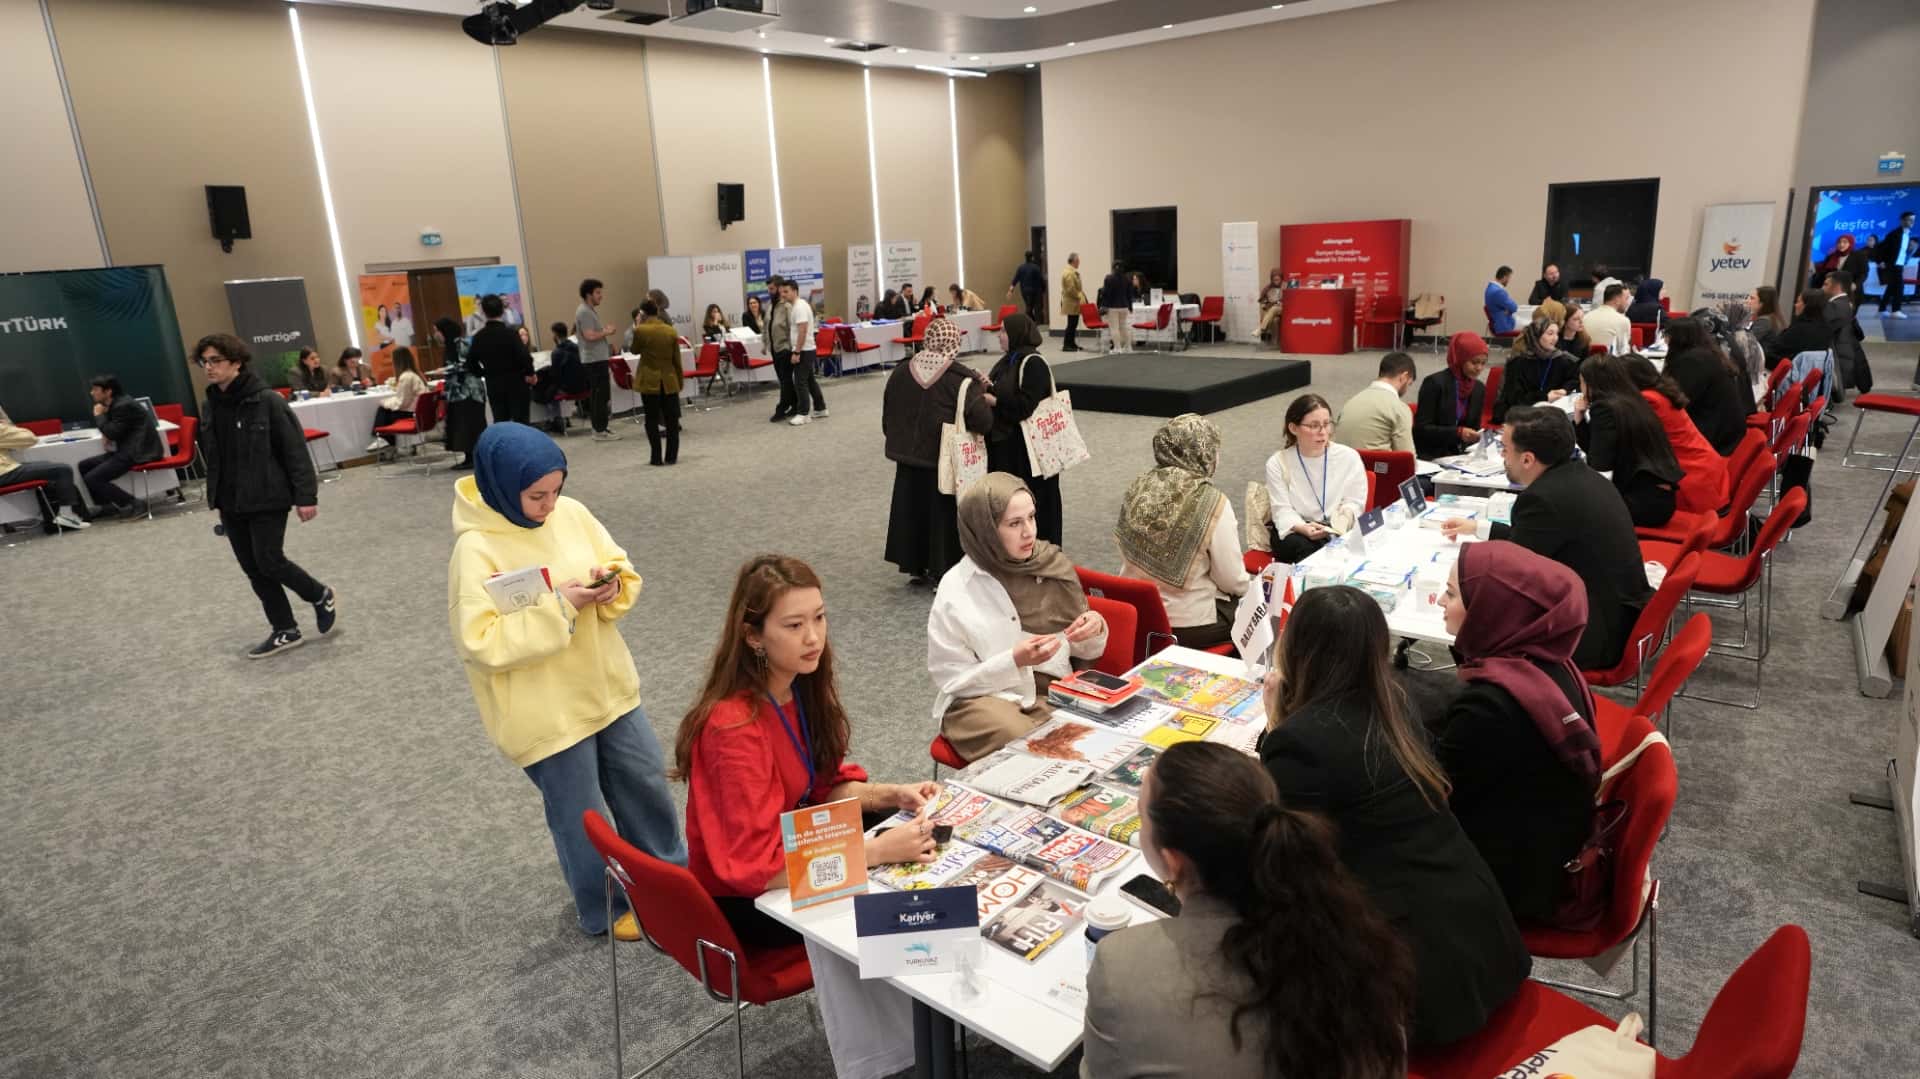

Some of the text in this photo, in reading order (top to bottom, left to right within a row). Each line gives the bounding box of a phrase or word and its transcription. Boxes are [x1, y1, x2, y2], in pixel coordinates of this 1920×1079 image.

[1834, 218, 1875, 232] keşfet
[705, 262, 739, 274] EROĞLU
[1710, 257, 1751, 272] yetev
[931, 848, 980, 877] Sofra
[1042, 833, 1088, 863] SABAH
[978, 866, 1038, 920] HOM
[1493, 1048, 1559, 1079] yete
